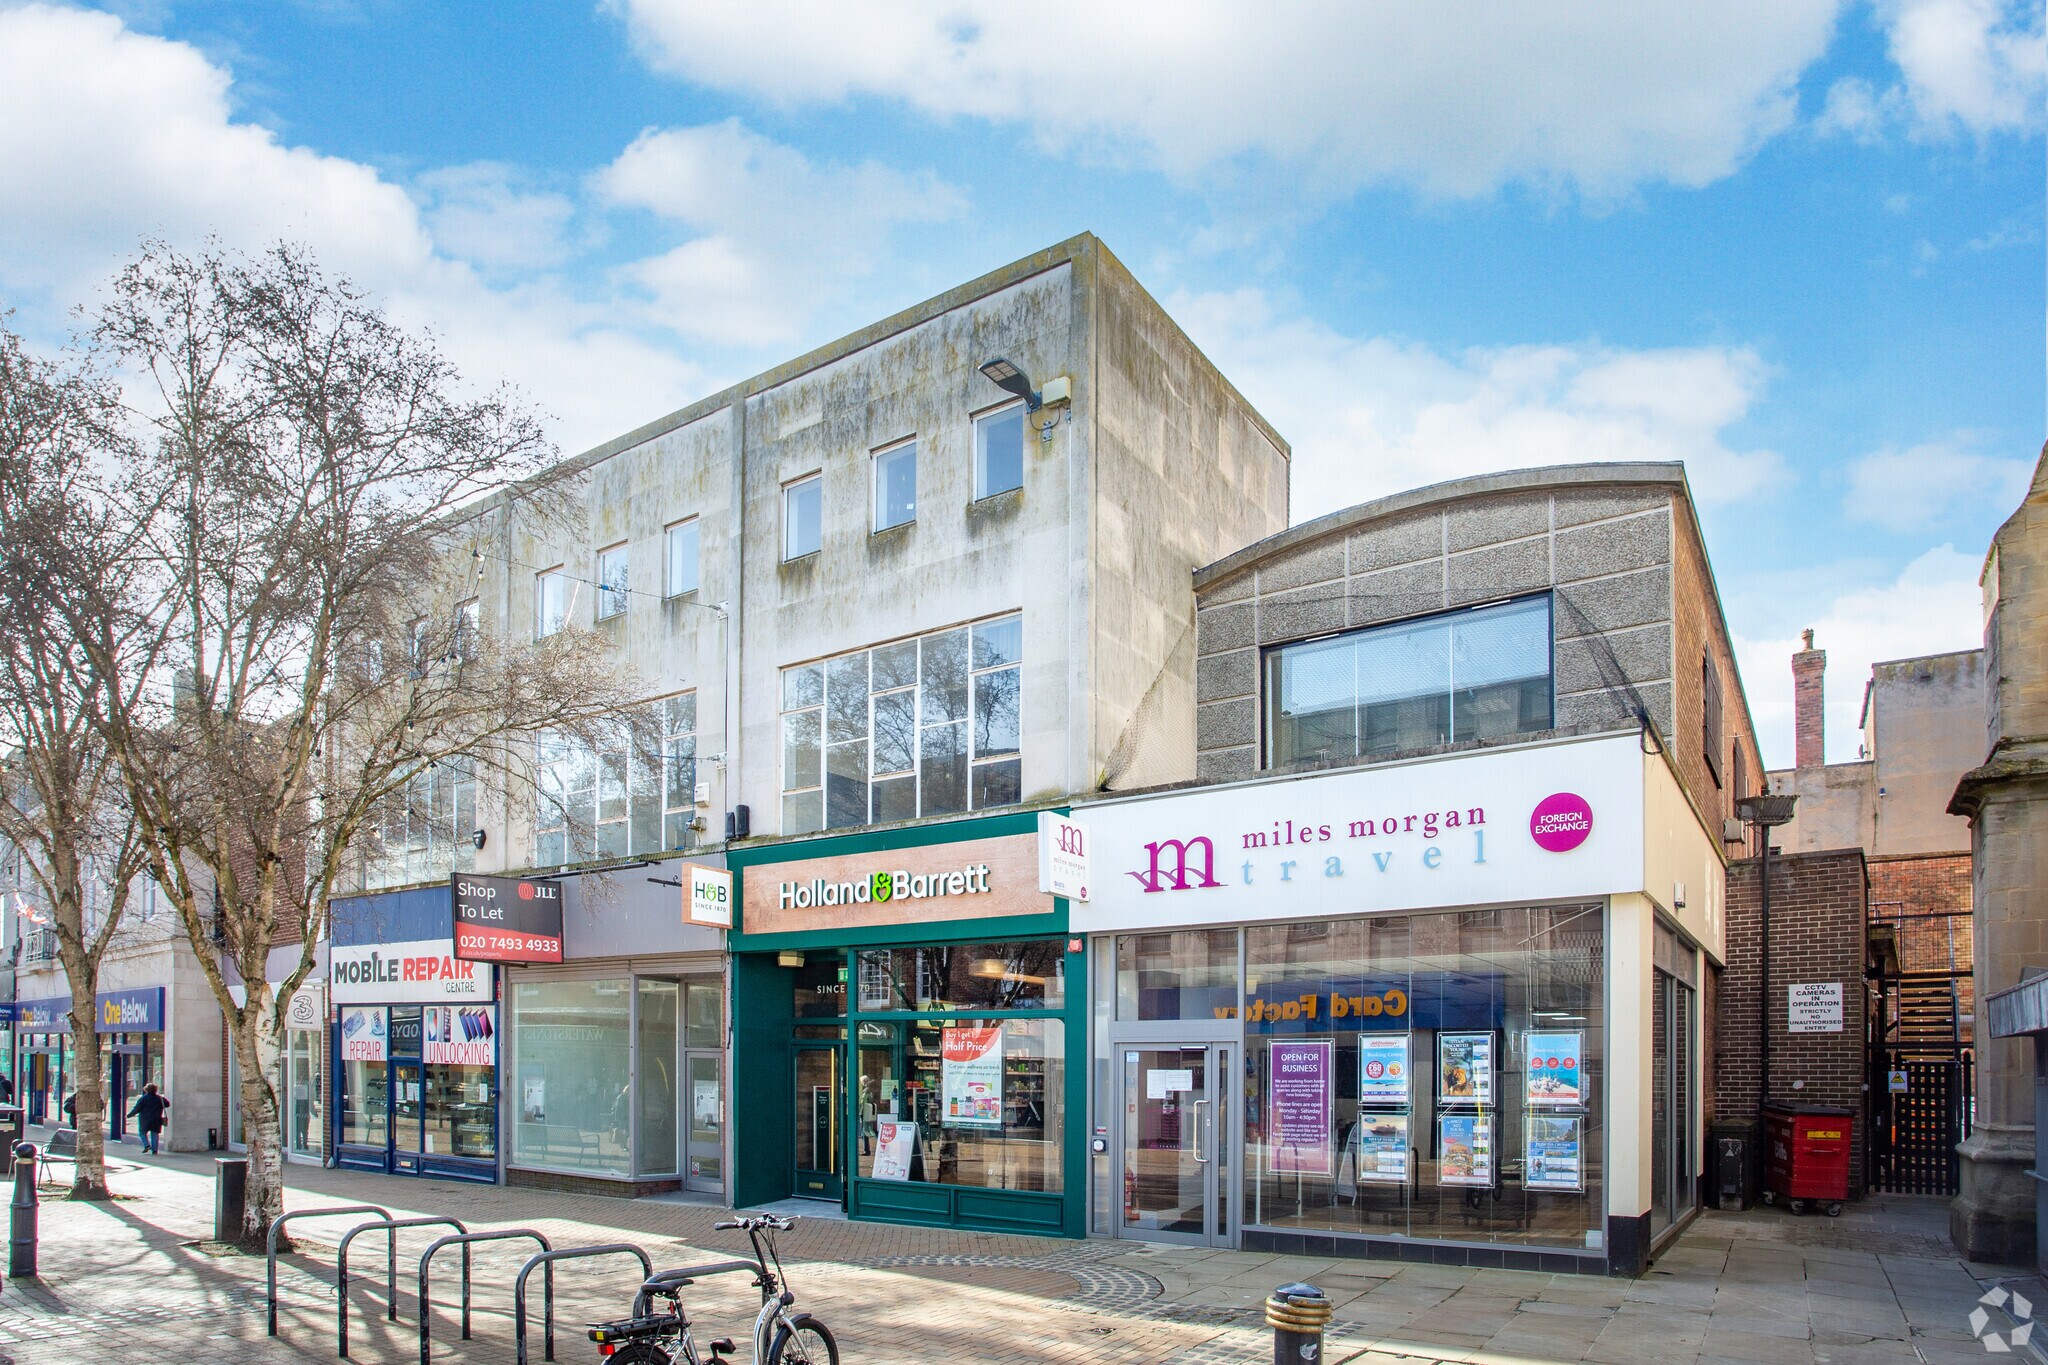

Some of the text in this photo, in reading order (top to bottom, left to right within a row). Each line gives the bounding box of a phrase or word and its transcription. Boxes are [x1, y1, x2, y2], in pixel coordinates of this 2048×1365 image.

[1540, 812, 1583, 824] FOREIGN
[1242, 807, 1487, 849] miles morgan
[1535, 820, 1589, 834] EXCHANGE
[1241, 829, 1487, 885] travel
[458, 883, 496, 901] Shop
[534, 886, 556, 899] JLL
[459, 904, 504, 919] To Let
[695, 903, 713, 911] SINCE
[460, 935, 559, 952] 020 7493 4933
[334, 951, 475, 984] MOBILE REPAIR
[446, 982, 475, 993] CENTRE
[816, 984, 846, 995] SINCE
[103, 999, 121, 1025] One
[293, 995, 315, 1021] 3
[945, 1030, 957, 1039] Buy
[961, 1031, 971, 1041] get
[349, 1041, 382, 1061] REPAIR
[945, 1041, 988, 1051] Half Price
[429, 1042, 490, 1065] UNLOCKING
[1280, 1053, 1319, 1061] OPEN FOR
[1282, 1064, 1318, 1072] BUSINESS
